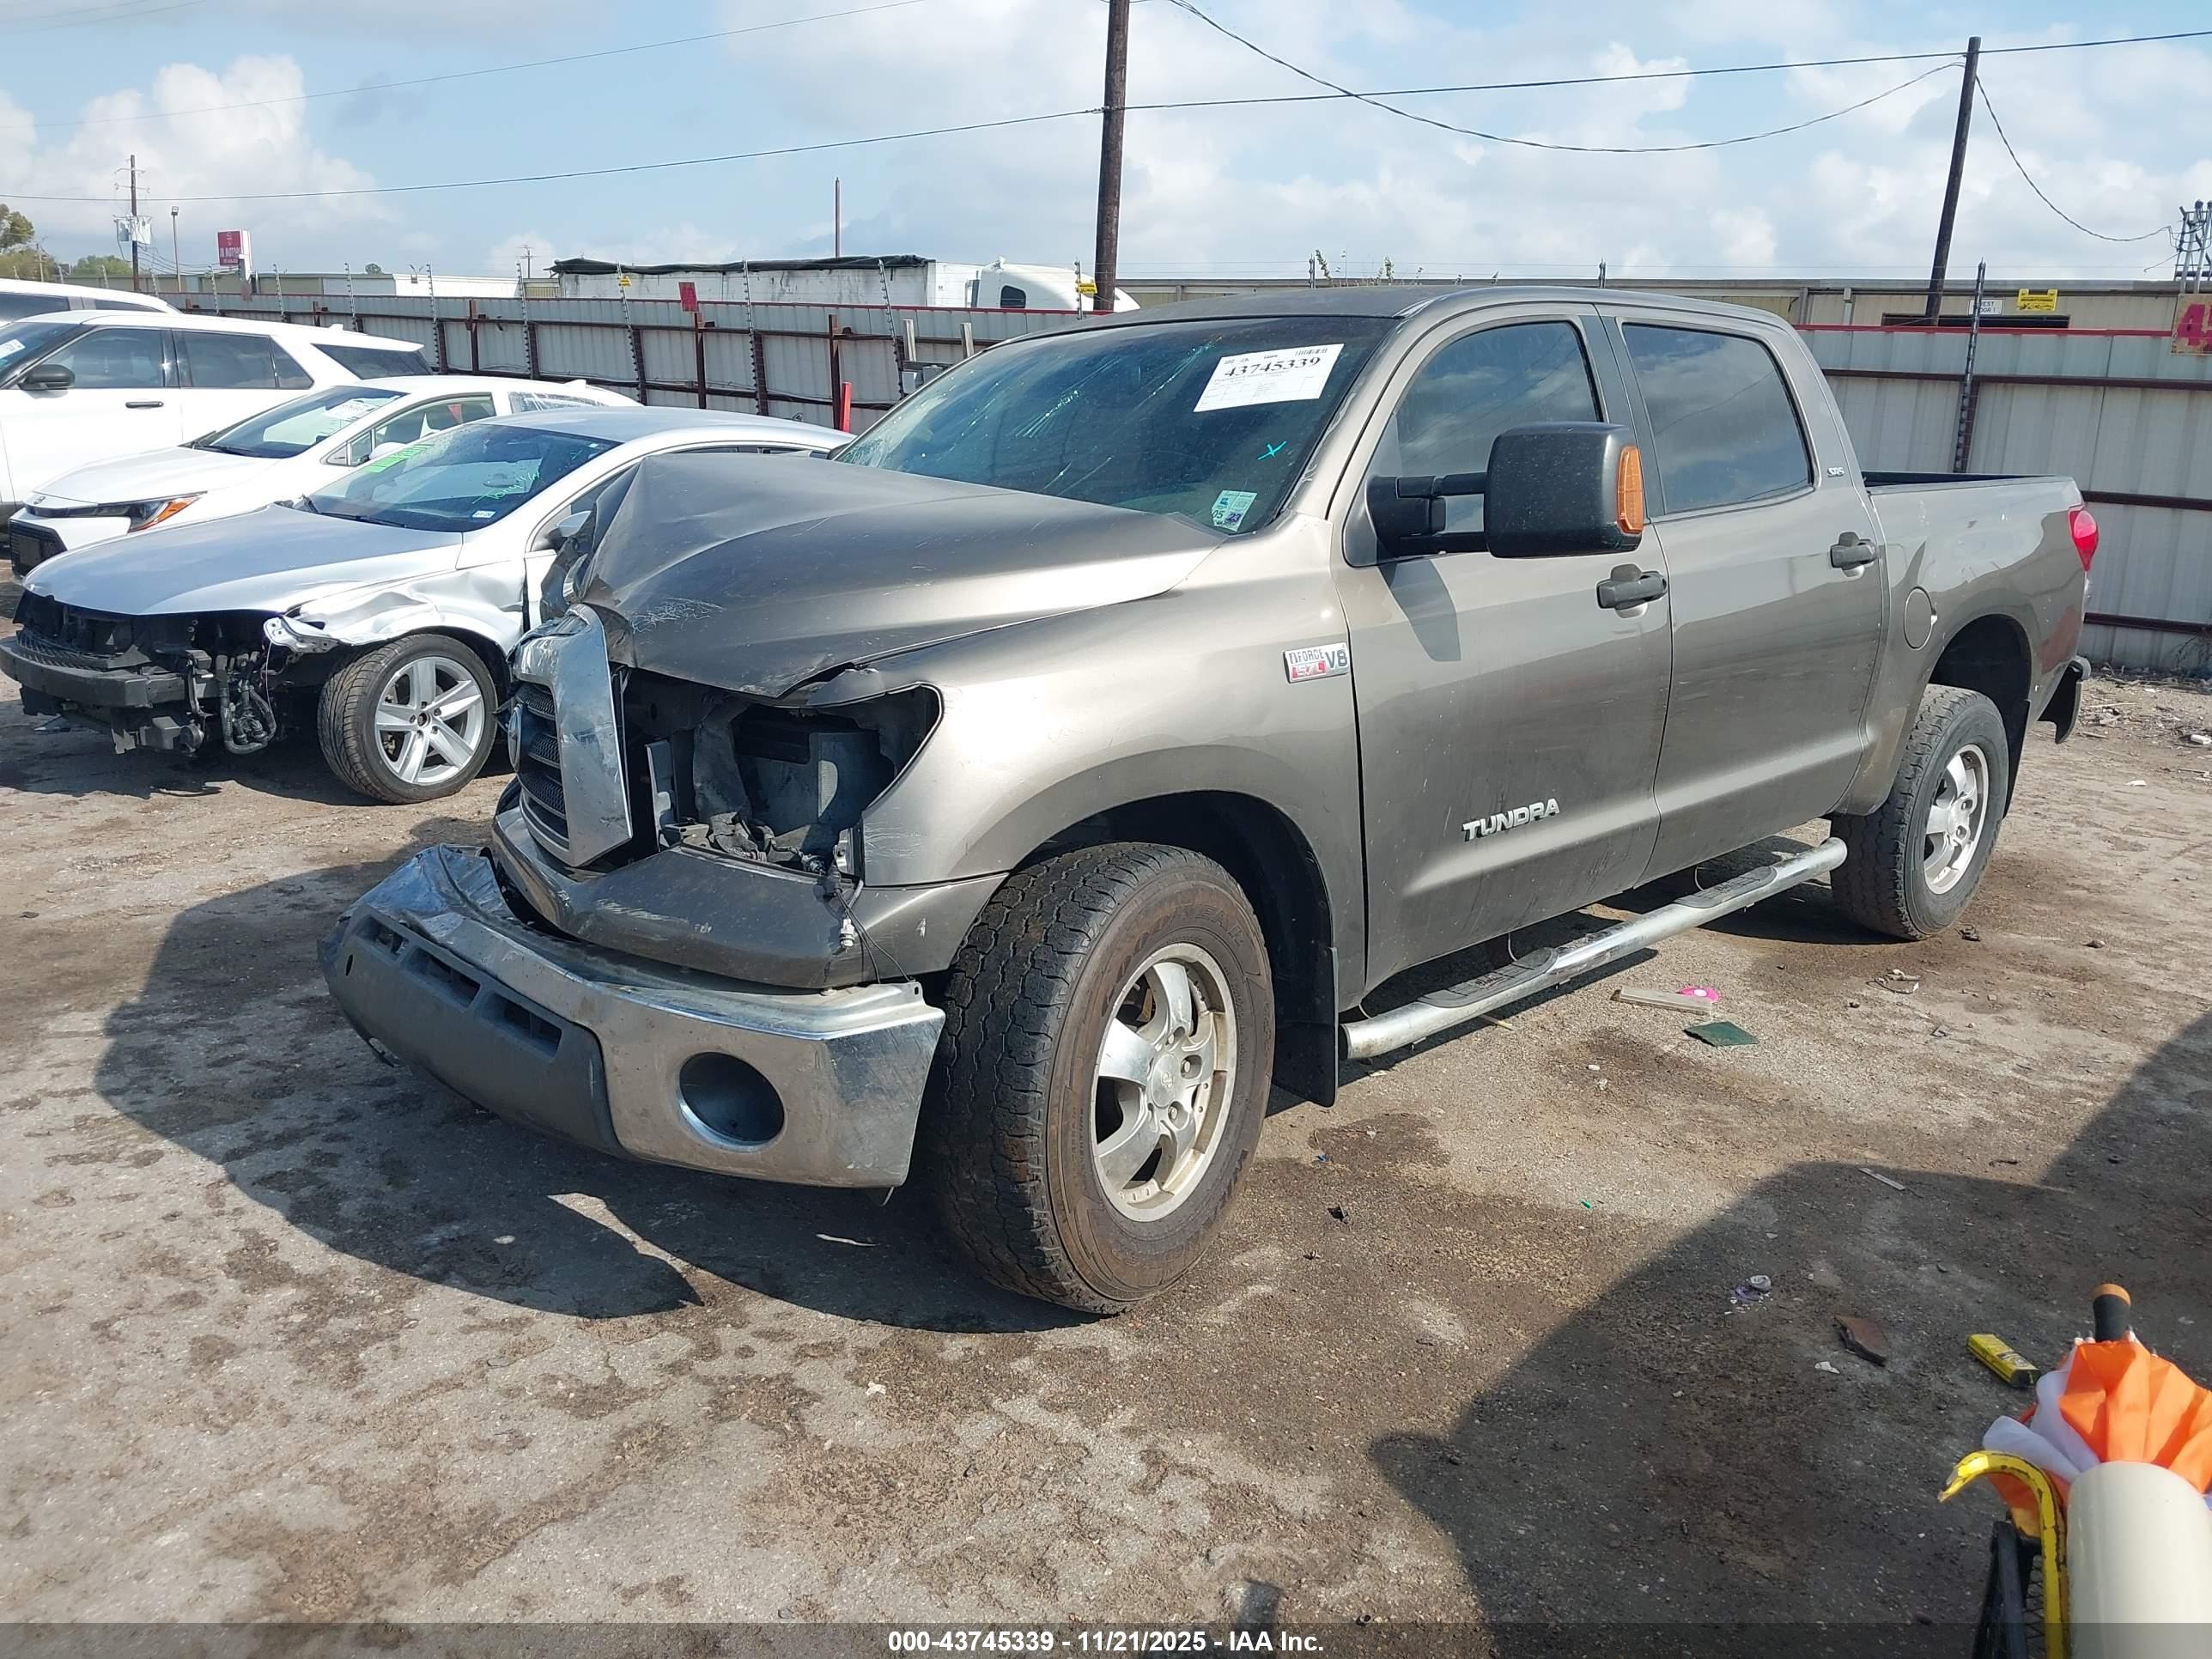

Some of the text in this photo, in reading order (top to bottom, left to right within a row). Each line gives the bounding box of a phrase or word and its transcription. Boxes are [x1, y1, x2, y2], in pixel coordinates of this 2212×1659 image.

[1224, 356, 1322, 377] 43745339
[1325, 648, 1347, 669] V8
[1462, 798, 1560, 842] TUNDRA
